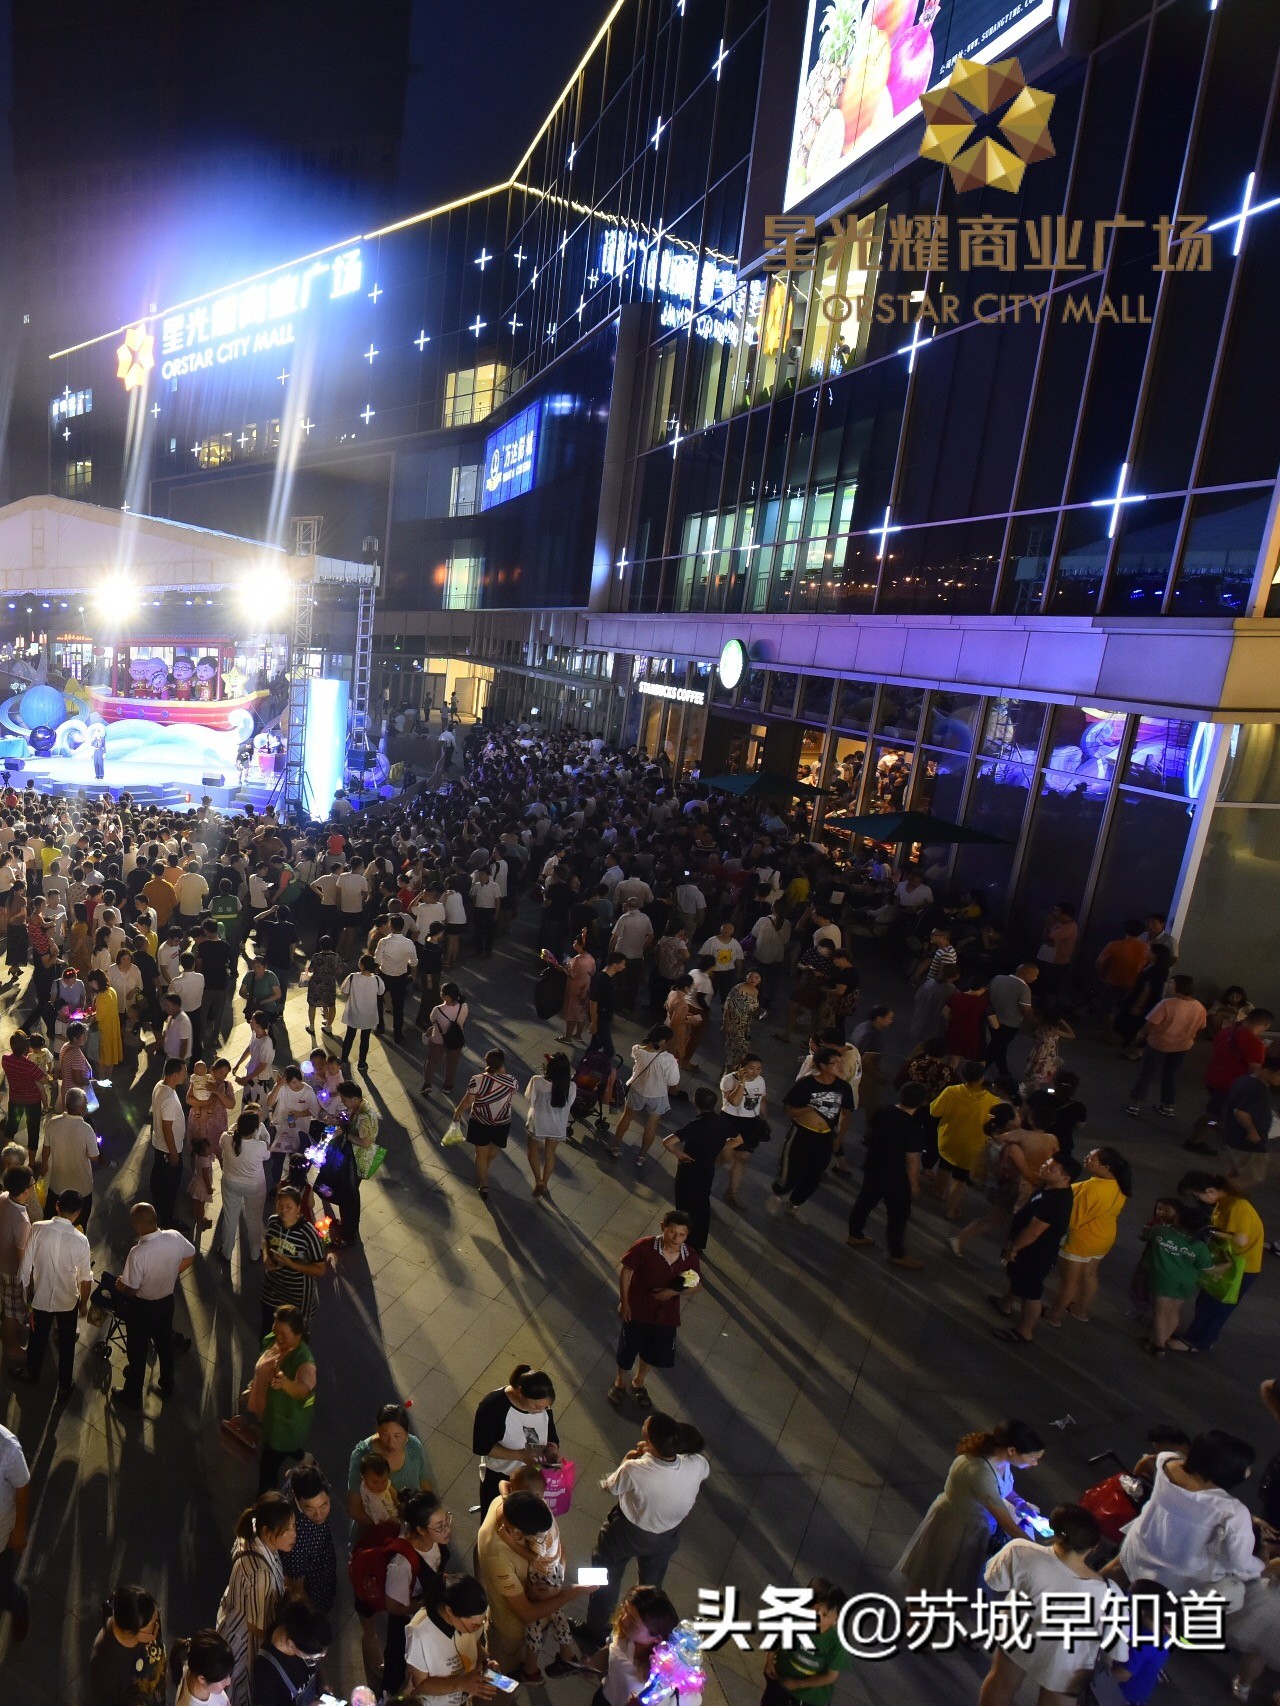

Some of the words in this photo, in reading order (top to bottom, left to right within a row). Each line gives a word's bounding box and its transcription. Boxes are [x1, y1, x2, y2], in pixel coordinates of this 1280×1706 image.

[162, 351, 213, 380] ORSTAR
[217, 336, 250, 363] CITY
[253, 324, 295, 352] MALL
